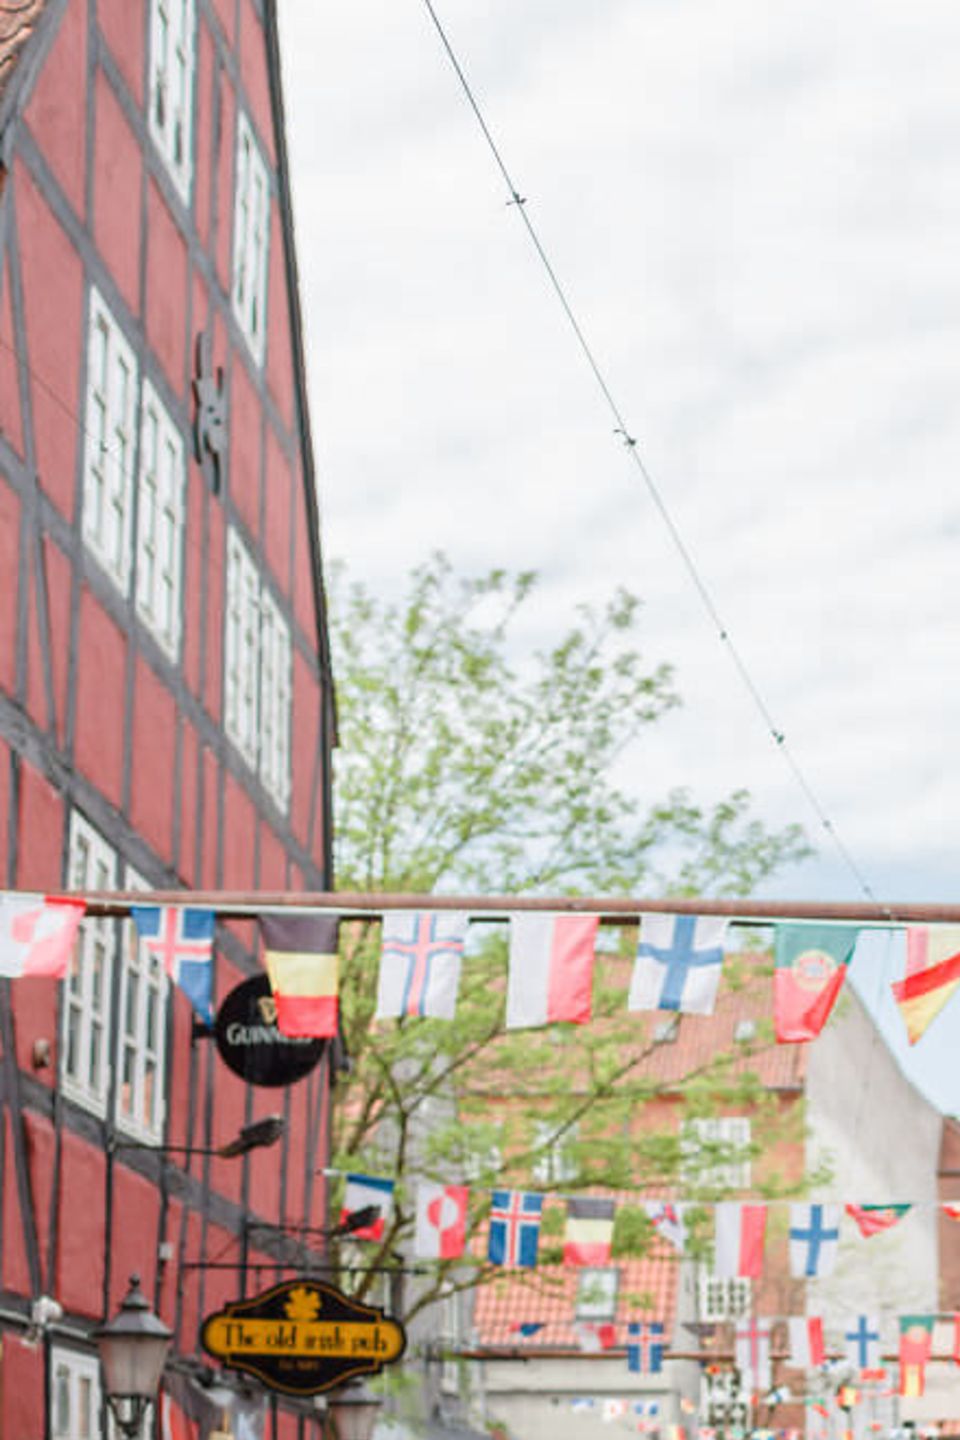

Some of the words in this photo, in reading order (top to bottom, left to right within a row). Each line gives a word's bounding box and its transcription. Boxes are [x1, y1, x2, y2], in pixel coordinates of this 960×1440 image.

[222, 1323, 255, 1347] The
[265, 1325, 298, 1348] old
[351, 1326, 388, 1353] pub
